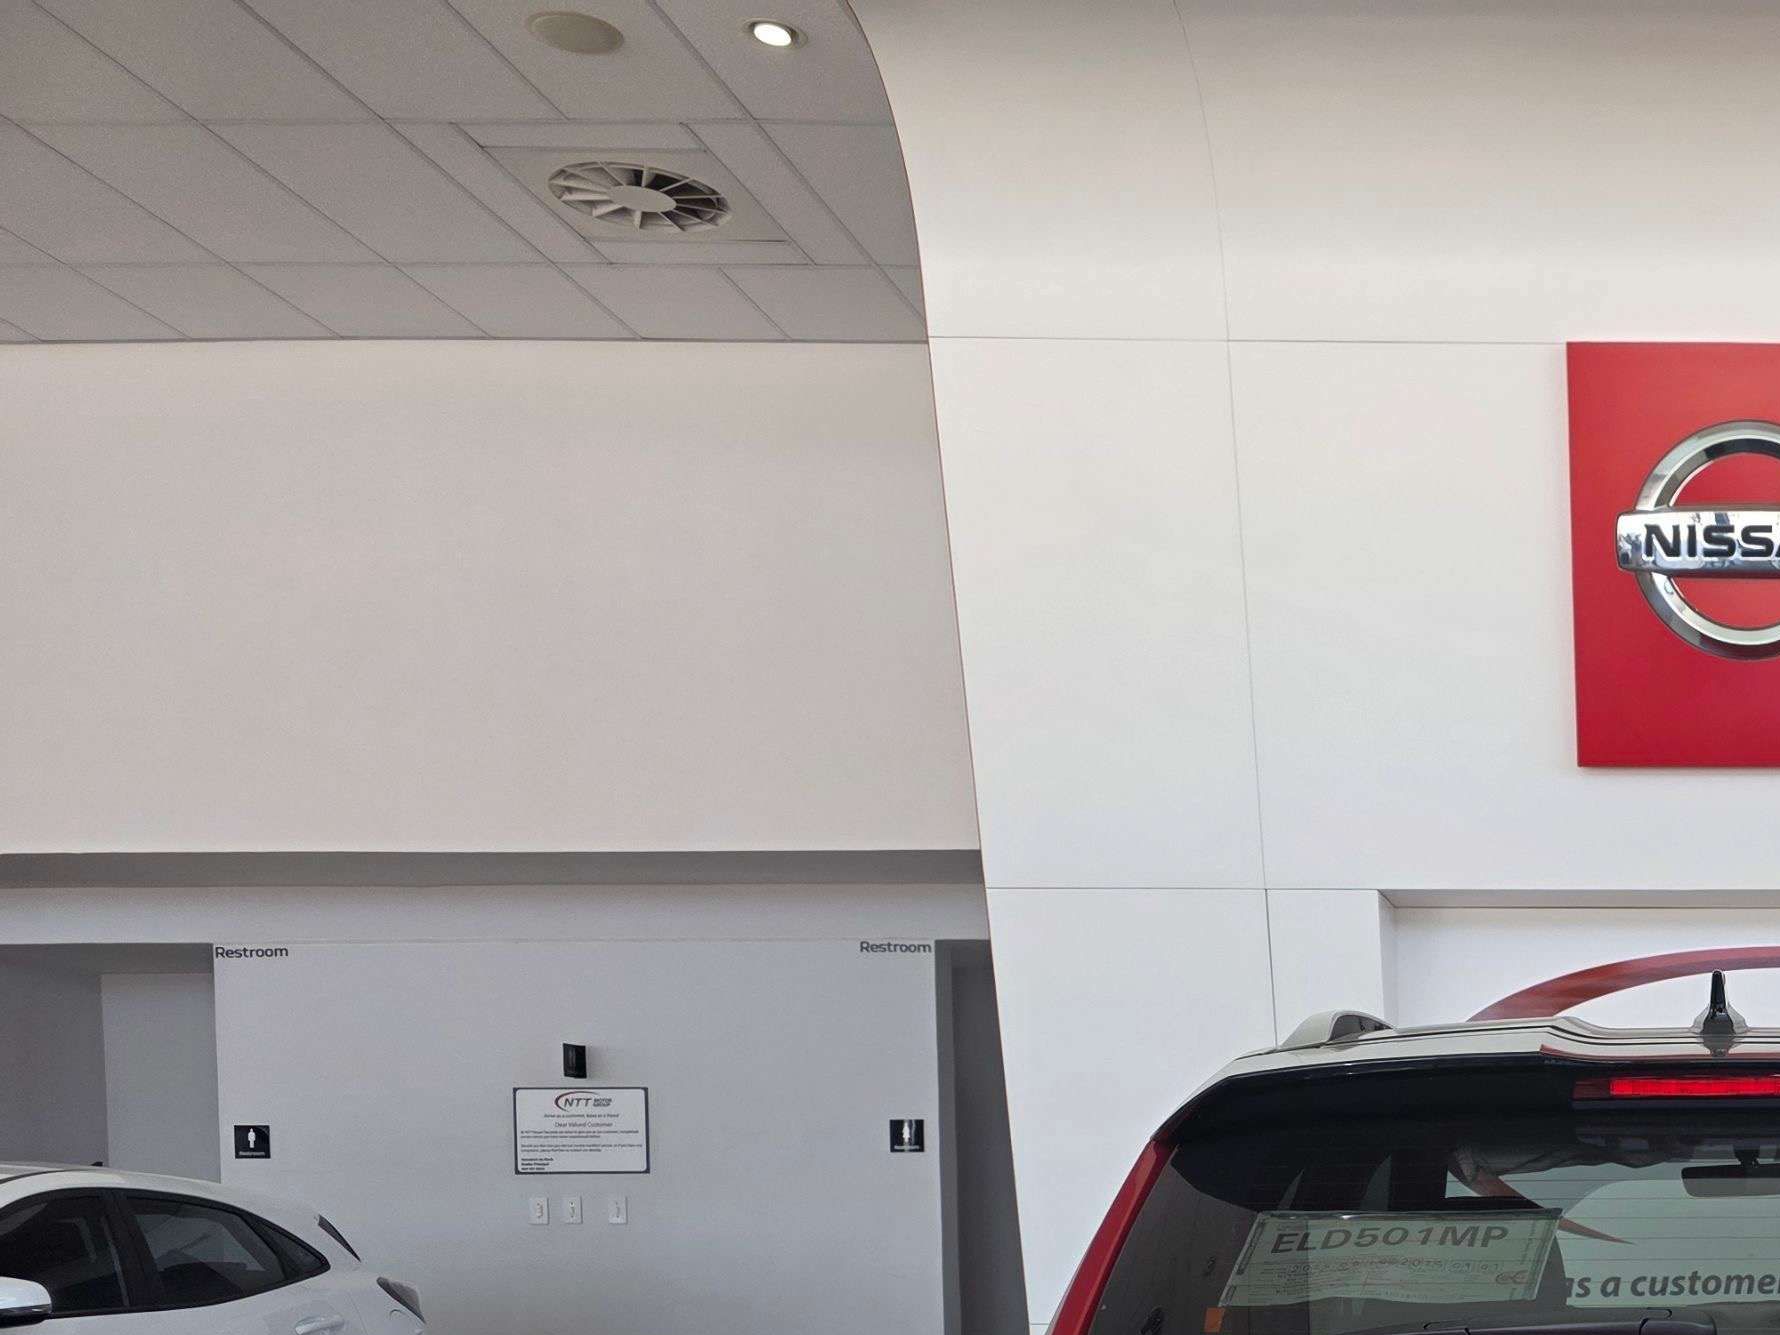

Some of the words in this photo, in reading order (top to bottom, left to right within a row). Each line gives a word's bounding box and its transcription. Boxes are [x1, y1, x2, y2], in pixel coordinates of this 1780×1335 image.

[215, 947, 288, 959] Restroom
[860, 941, 932, 953] Restroom
[563, 1098, 592, 1107] NTT
[1271, 1226, 1510, 1254] ELD501MP
[1601, 1277, 1621, 1297] a
